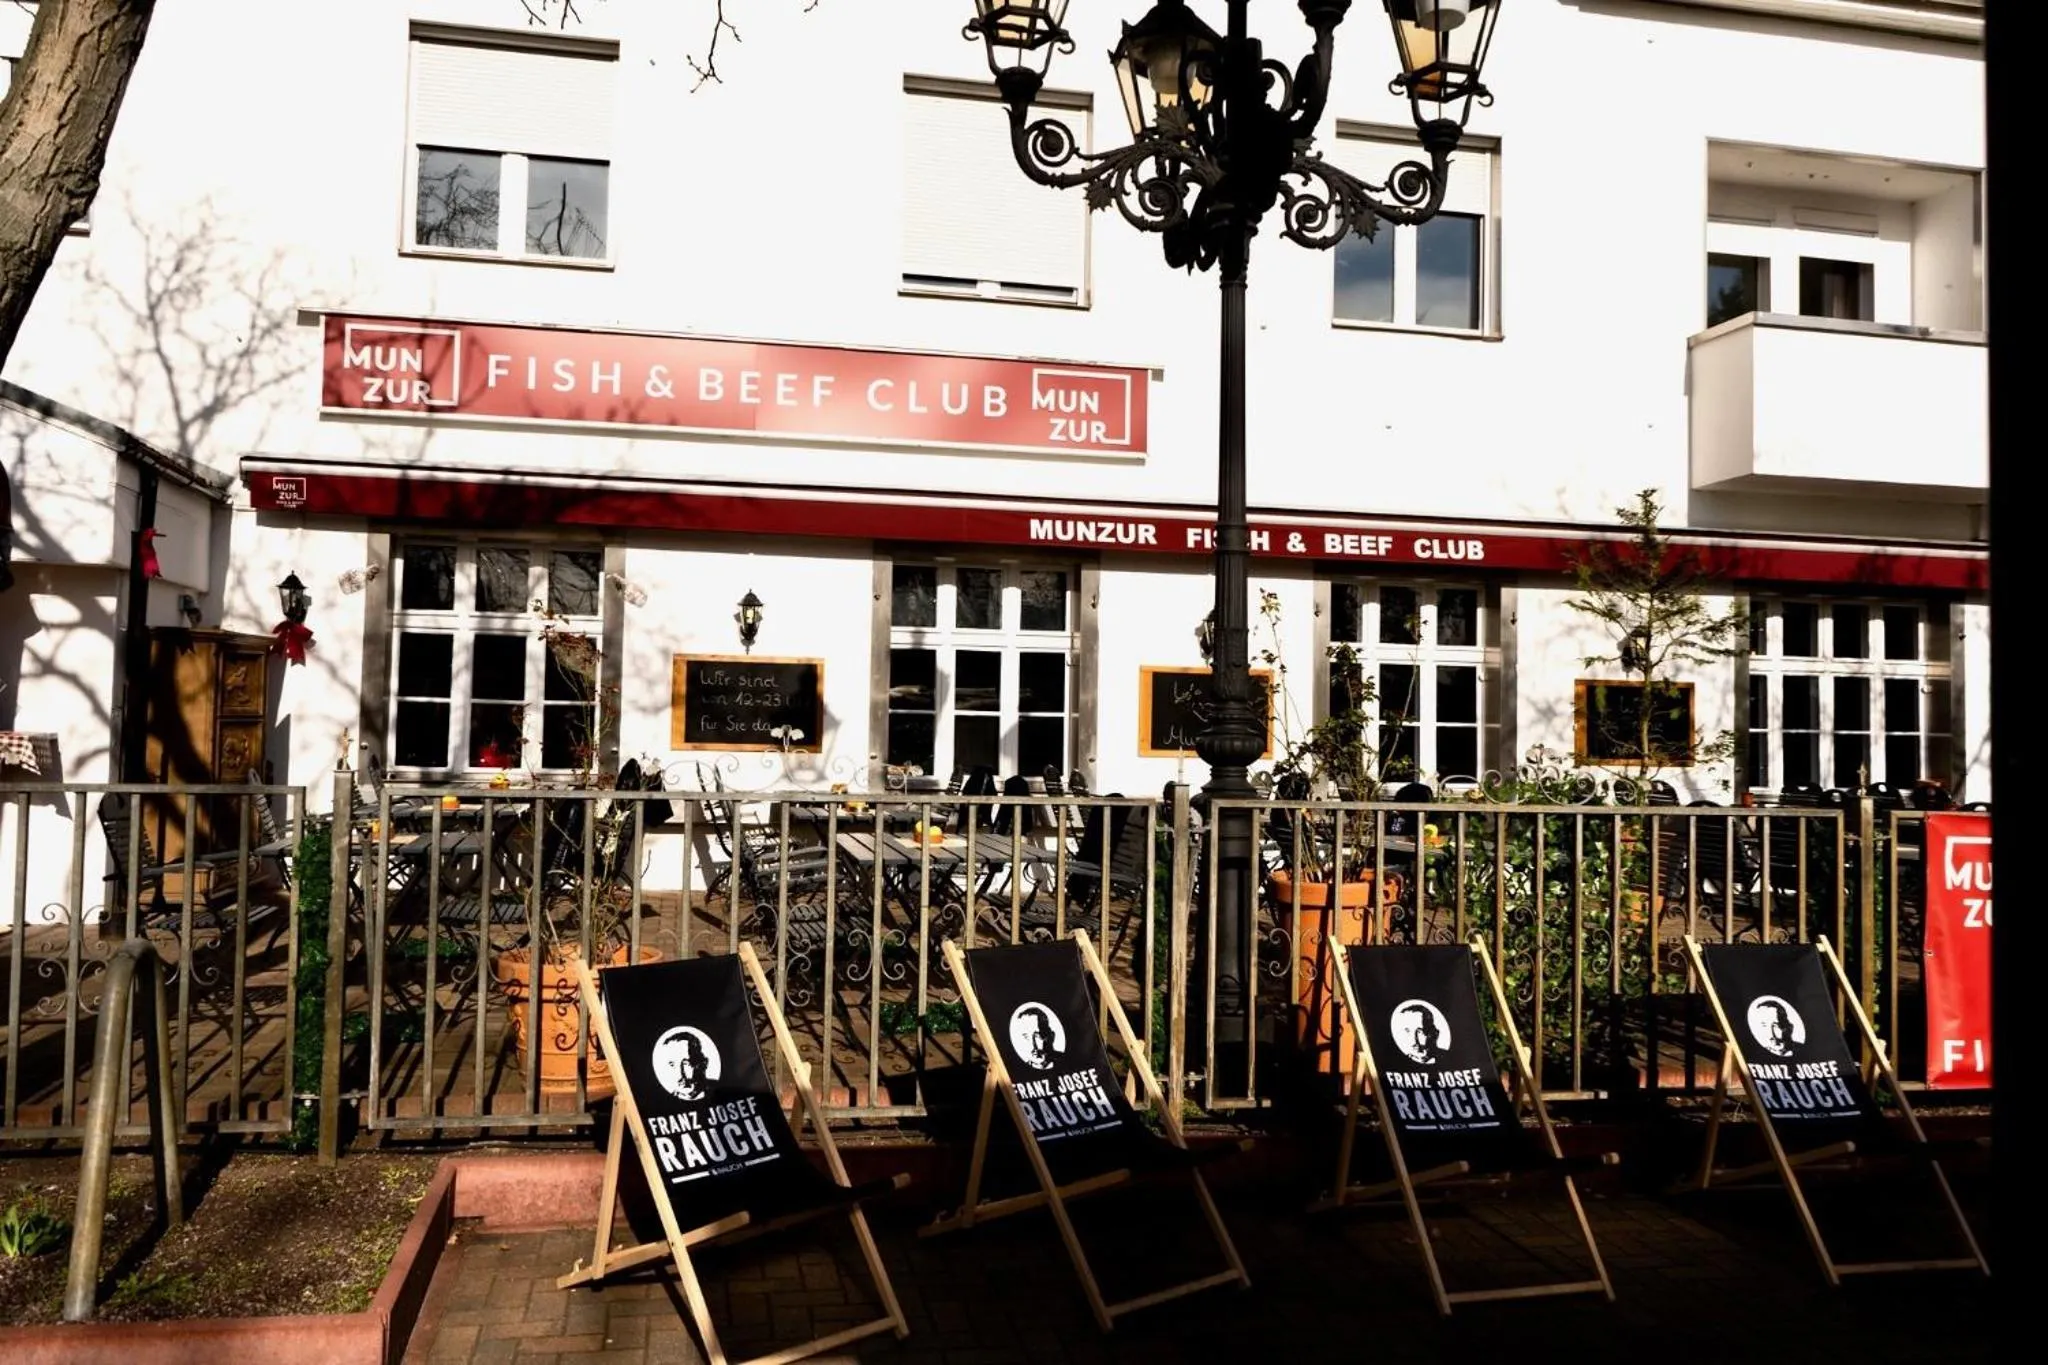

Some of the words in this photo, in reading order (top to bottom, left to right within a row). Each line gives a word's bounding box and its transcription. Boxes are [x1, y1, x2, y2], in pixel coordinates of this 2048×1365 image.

[343, 344, 423, 373] MUN
[362, 376, 431, 404] ZUR
[487, 353, 621, 396] FISH
[644, 364, 675, 399] &
[698, 367, 836, 408] BEEF
[866, 378, 1008, 417] CLUB
[1032, 388, 1100, 414] MUN
[1048, 417, 1107, 444] ZUR
[1029, 518, 1158, 546] MUNZUR
[1286, 531, 1307, 554] &
[1323, 533, 1393, 557] BEEF
[1413, 538, 1485, 561] CLUB
[700, 669, 731, 687] Wir
[738, 674, 780, 688] sind
[1057, 1068, 1098, 1094] JOSEF
[1385, 1071, 1432, 1089] FRANZ
[1437, 1068, 1481, 1088] JOSEF
[1748, 1063, 1792, 1080] FRANZ
[1796, 1060, 1838, 1079] JOSEF
[1391, 1086, 1496, 1120] RAUCH
[1755, 1077, 1856, 1109] RAUCH
[647, 1111, 702, 1137] FRANZ
[707, 1096, 758, 1126] JOSEF
[1020, 1086, 1116, 1132] RAUCH
[654, 1115, 775, 1173] RAUCH
